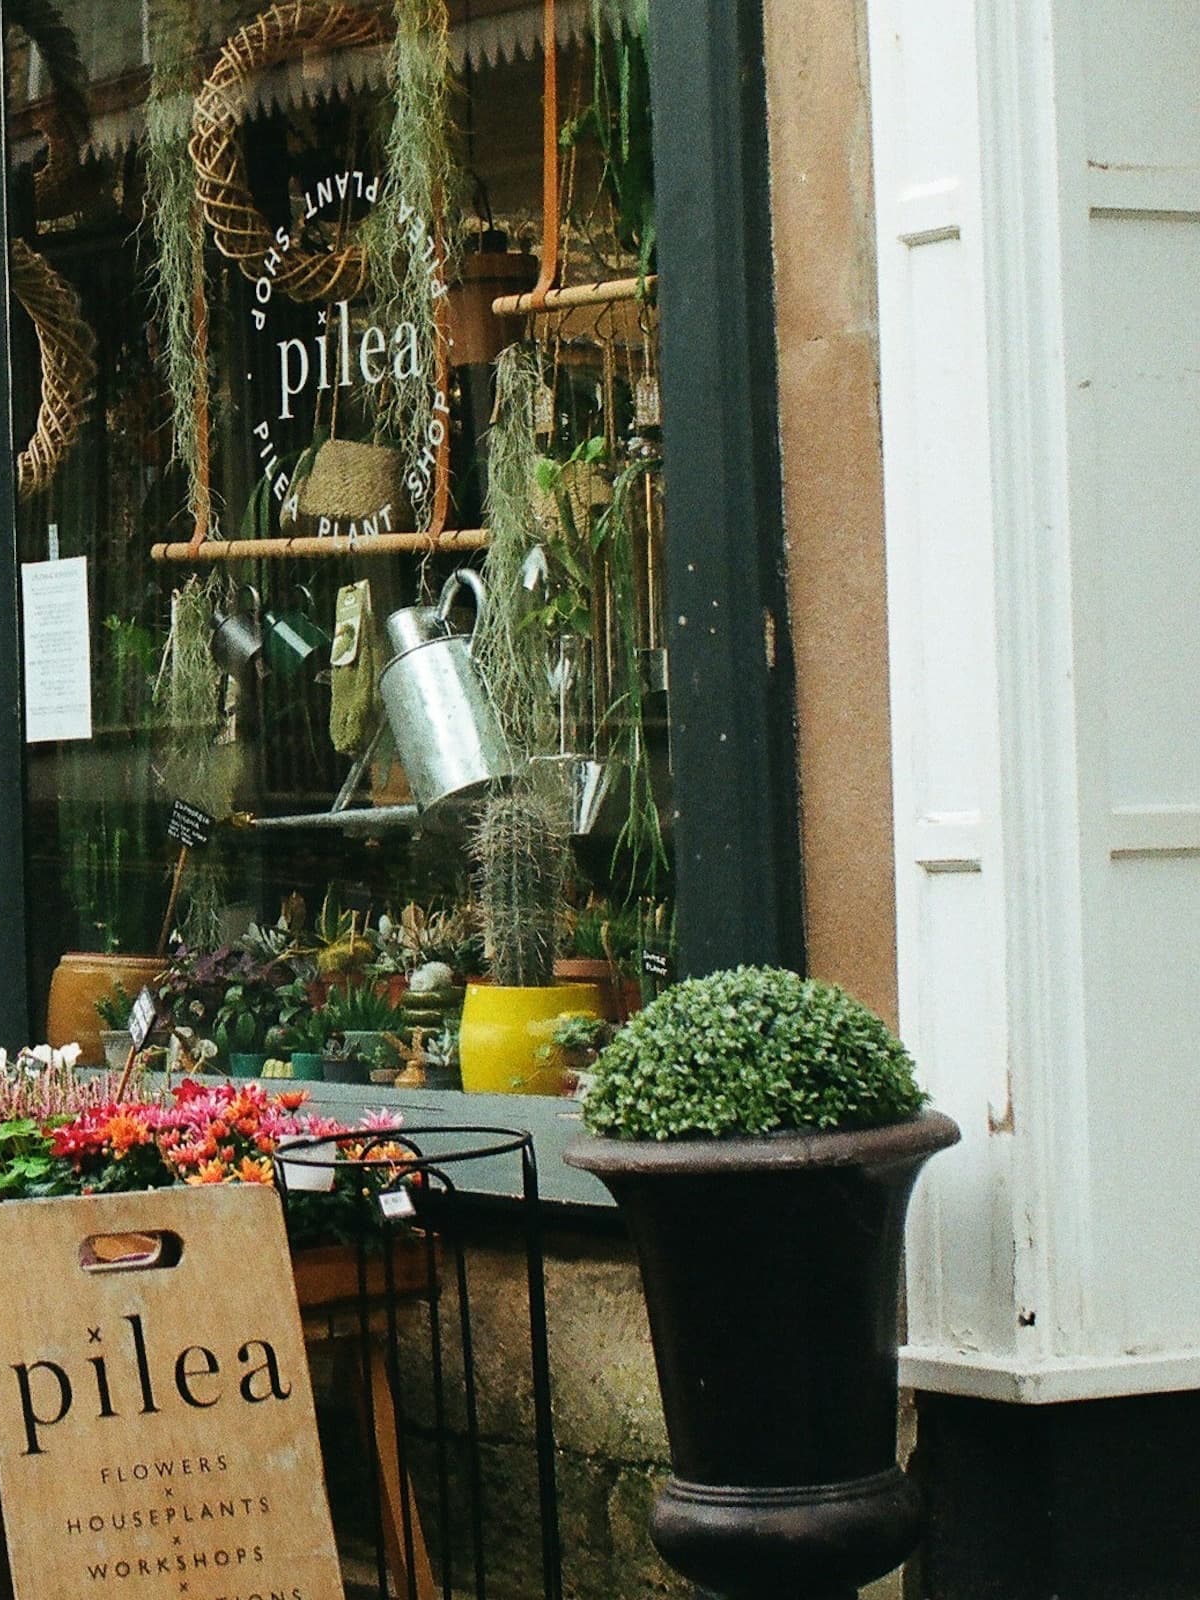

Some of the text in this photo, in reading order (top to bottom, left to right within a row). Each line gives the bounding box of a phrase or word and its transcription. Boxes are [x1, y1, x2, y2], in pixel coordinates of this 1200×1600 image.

[303, 171, 380, 219] PLANT
[255, 226, 291, 331] SHOP
[277, 300, 423, 420] pilea
[253, 391, 451, 550] PILEA PLANT SHOP
[9, 1314, 292, 1457] pilea
[100, 1454, 229, 1485] FLOWERS
[66, 1496, 271, 1535] HOUSEPLANTS
[87, 1545, 265, 1581] WORKSHOPS
